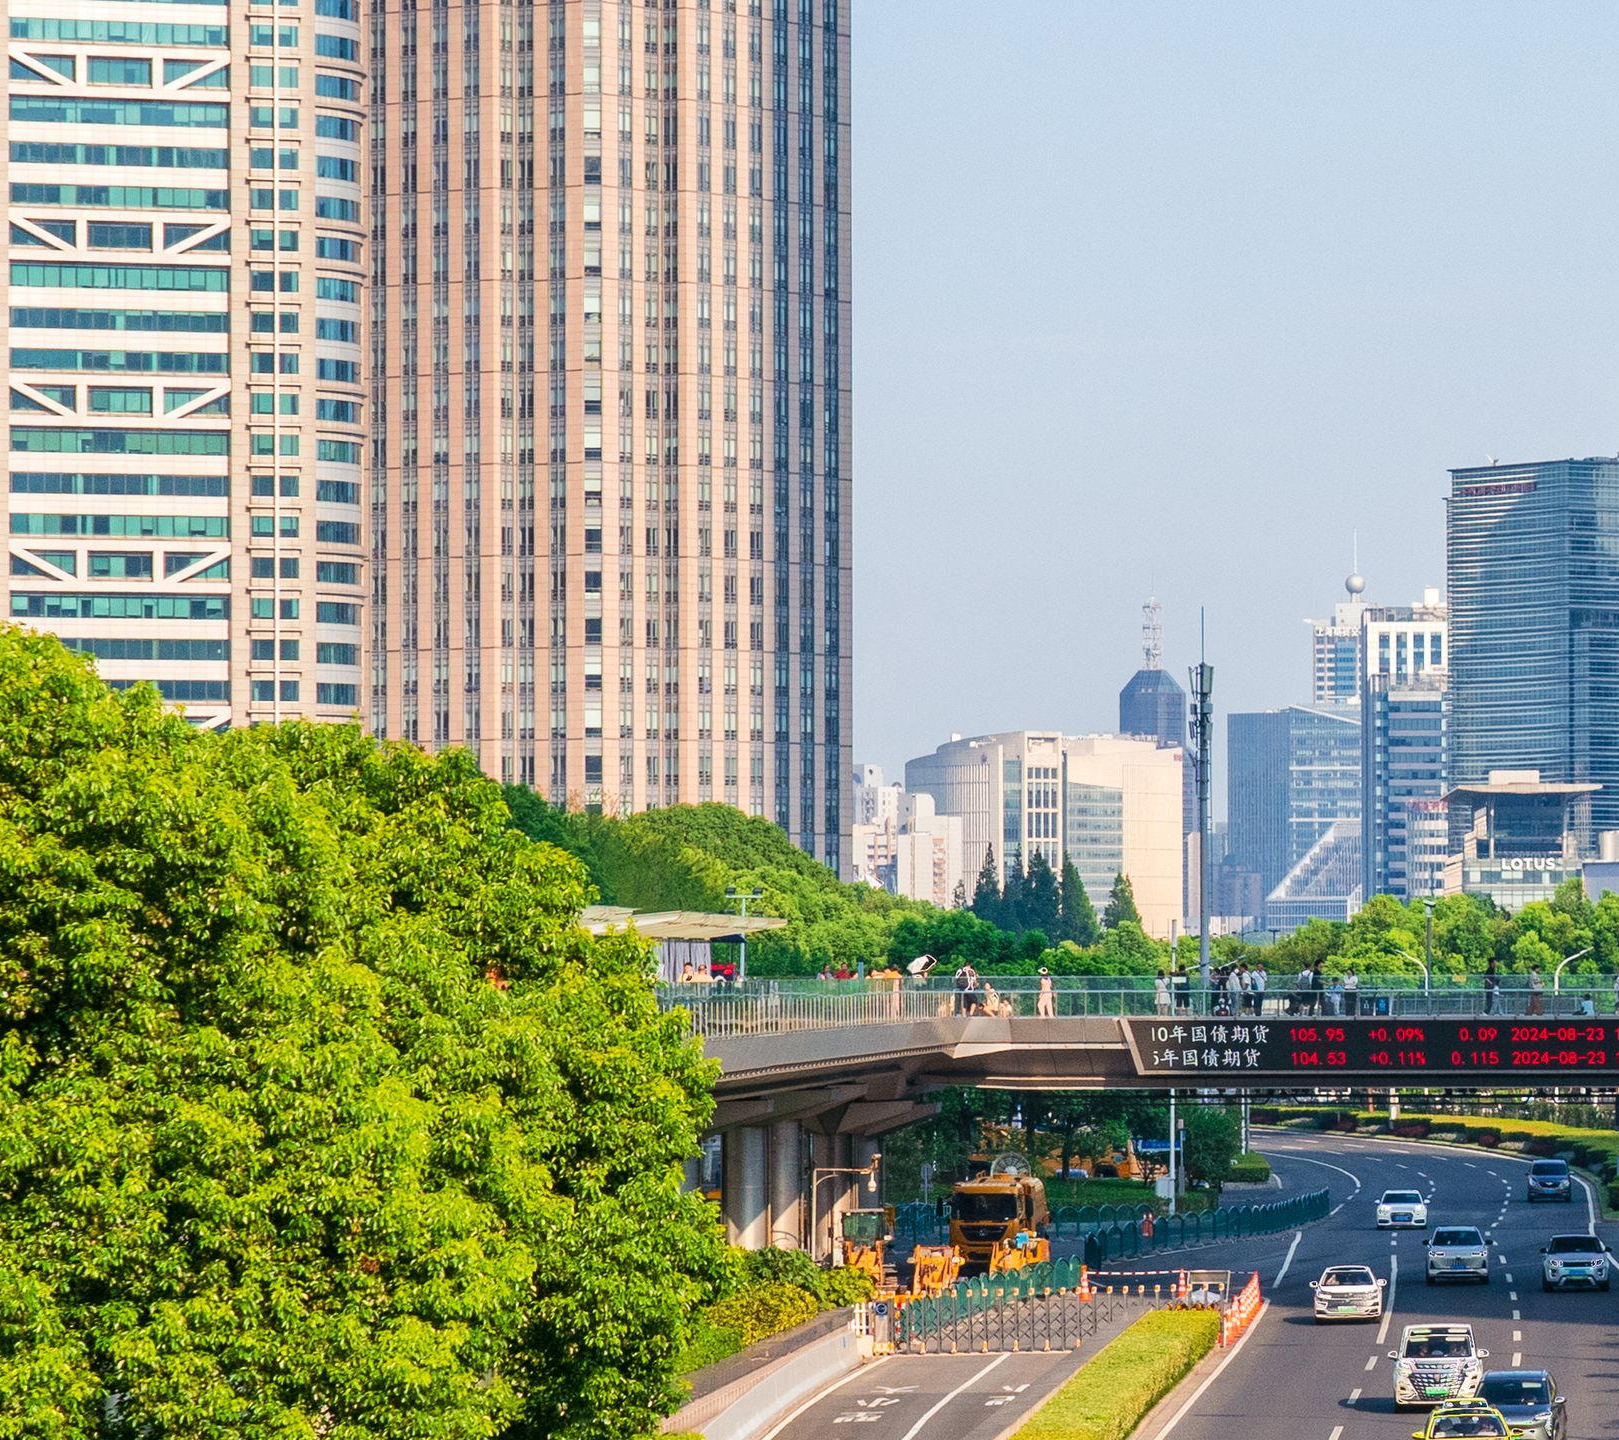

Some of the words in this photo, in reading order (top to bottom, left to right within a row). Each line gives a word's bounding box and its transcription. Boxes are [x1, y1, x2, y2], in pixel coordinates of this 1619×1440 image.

[1501, 857, 1557, 871] LOTUS
[1151, 1023, 1270, 1044] 10年国债期货
[1290, 1027, 1346, 1043] 105.95
[1368, 1027, 1425, 1043] +0.09%
[1459, 1027, 1498, 1042] 0.09
[1511, 1026, 1605, 1042] 2024-08-23
[1291, 1051, 1347, 1066] 104.53
[1369, 1051, 1427, 1066] +0.11%
[1451, 1051, 1500, 1066] 0.115
[1512, 1050, 1606, 1066] 2024-08-23
